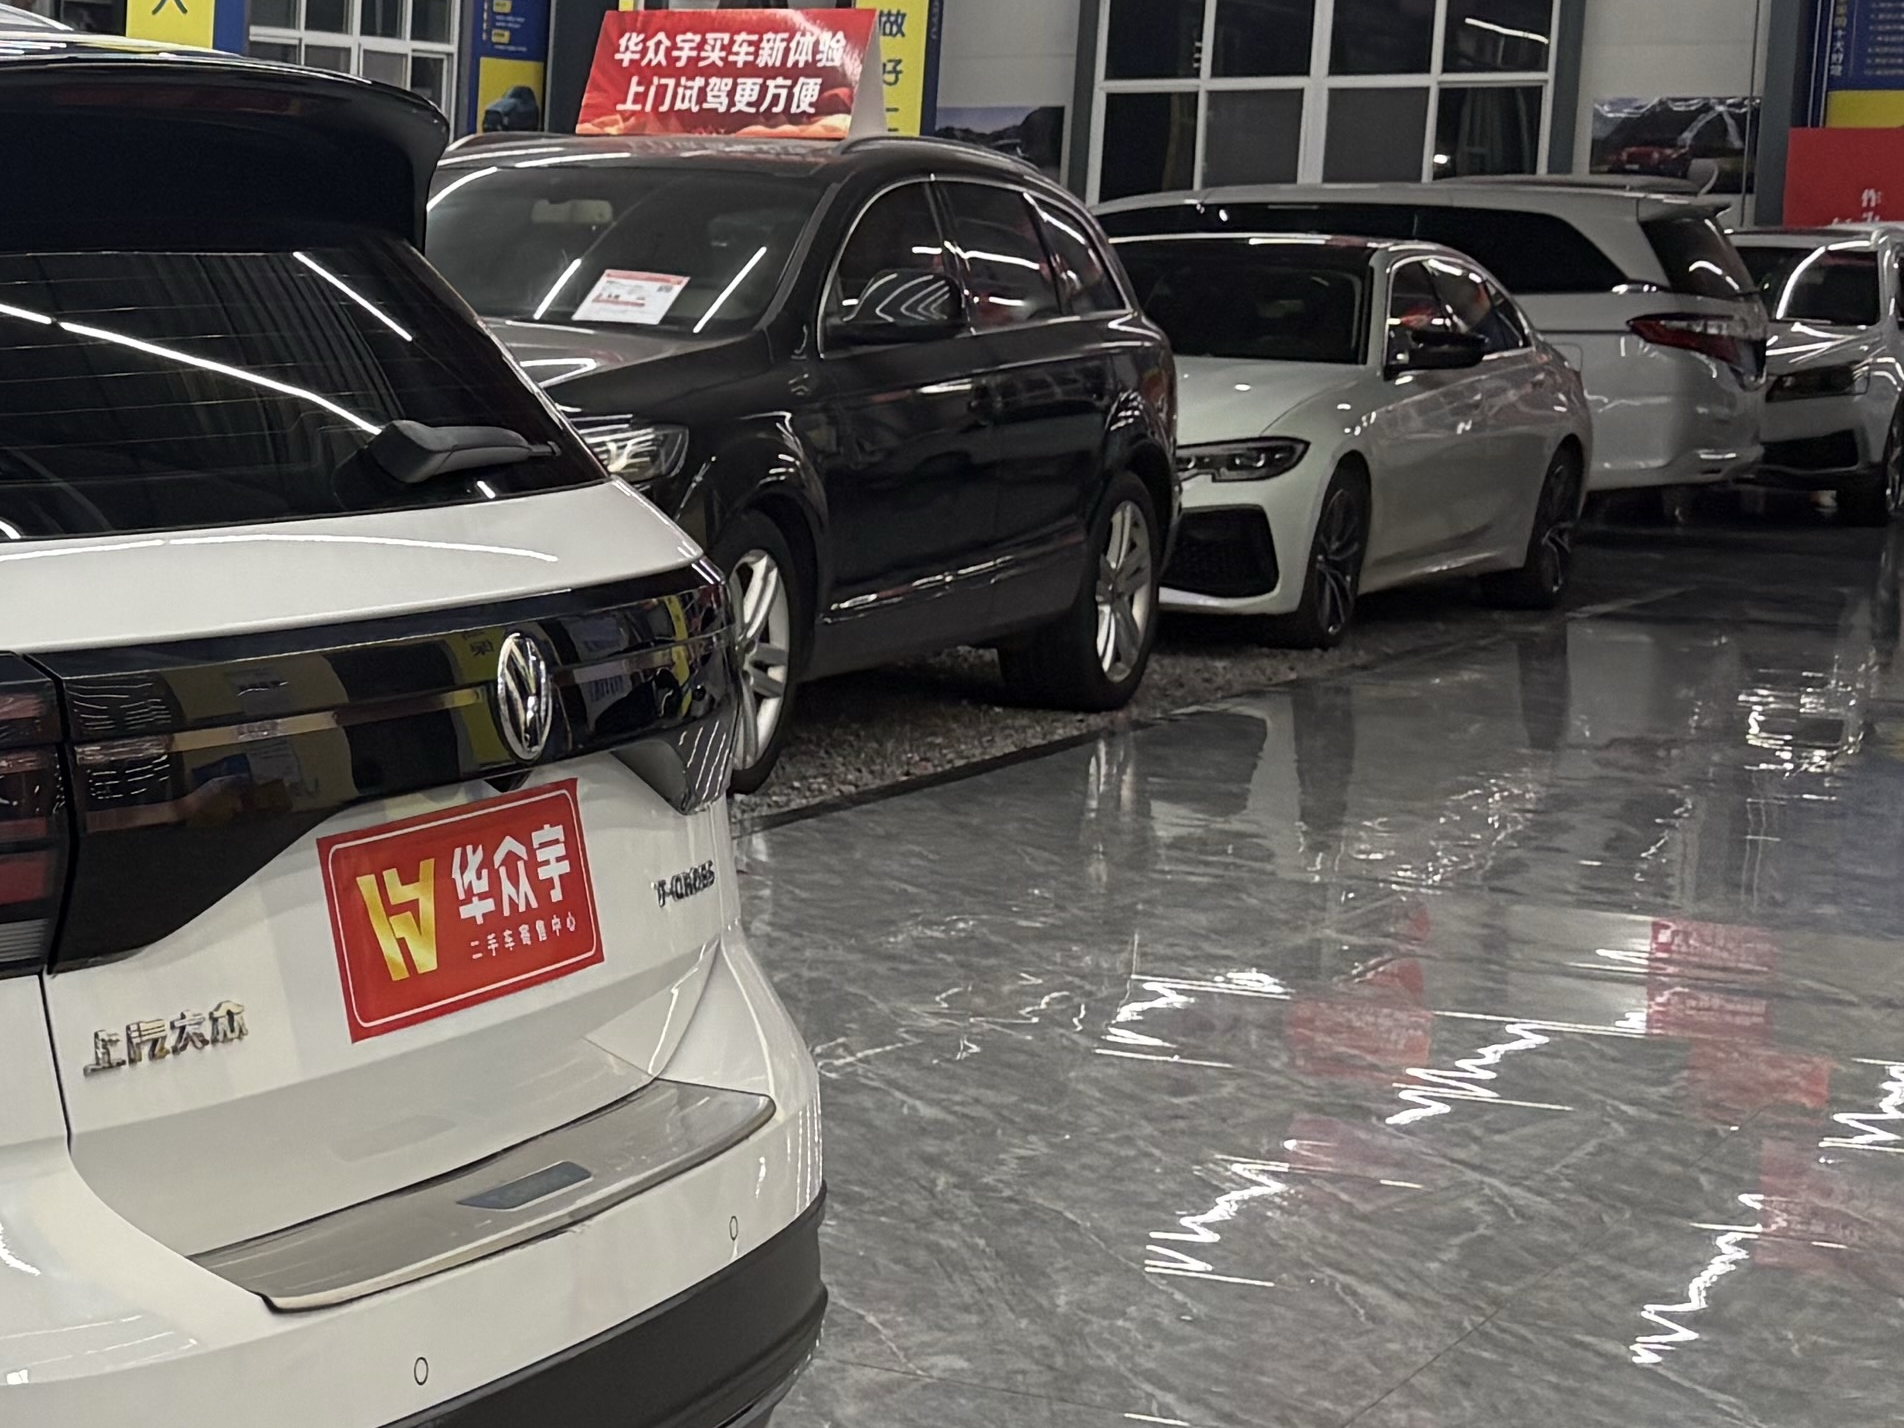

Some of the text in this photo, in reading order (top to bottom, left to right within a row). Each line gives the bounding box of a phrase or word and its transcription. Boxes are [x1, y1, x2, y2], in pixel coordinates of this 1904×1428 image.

[614, 30, 847, 68] 华众宇买车新体验
[616, 75, 823, 115] 上门试驾更方便
[452, 824, 570, 925] 华众宇
[470, 912, 576, 960] 二手车寄售中心
[83, 1000, 249, 1077] 上汽大众
